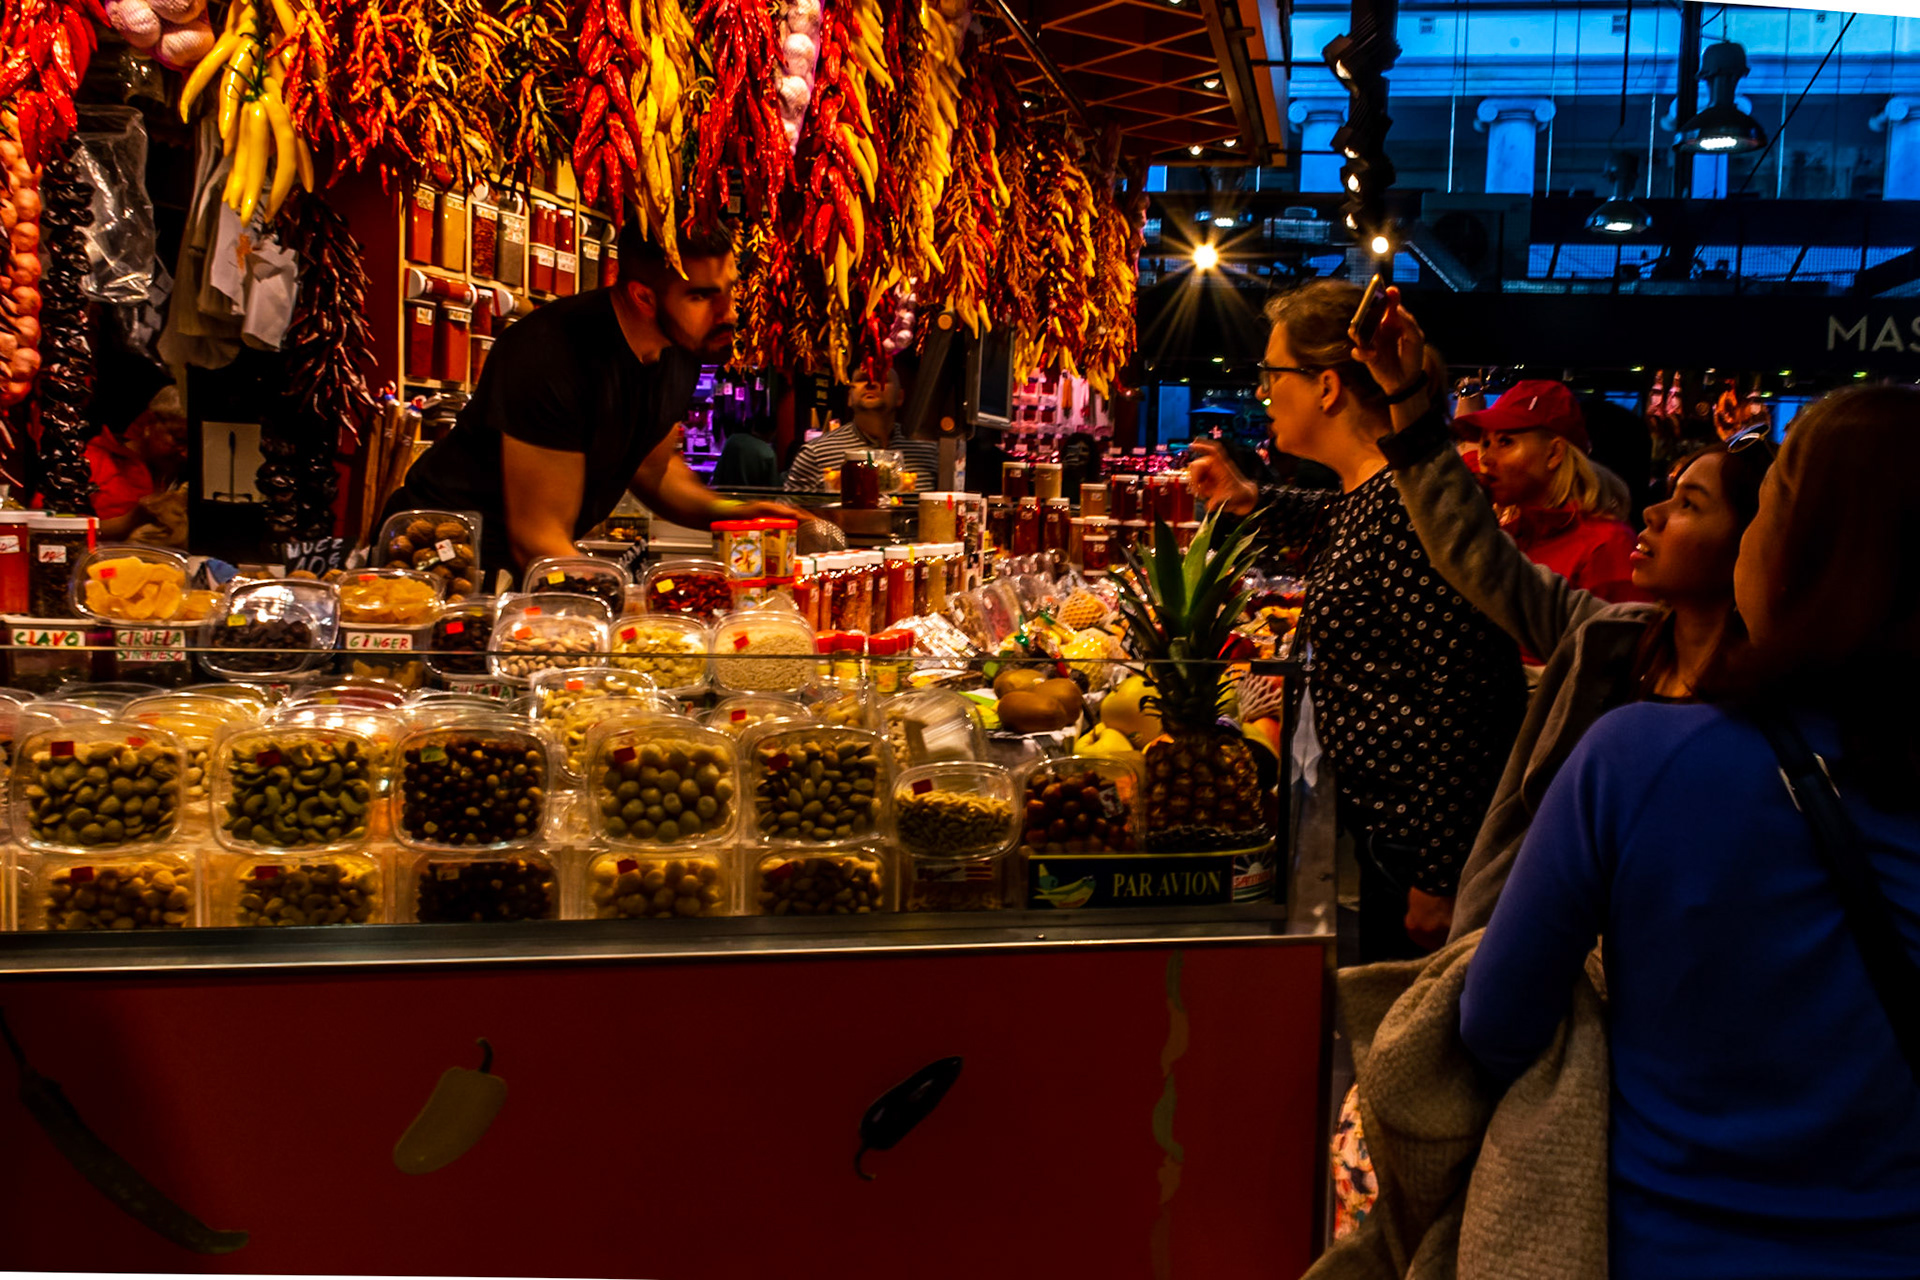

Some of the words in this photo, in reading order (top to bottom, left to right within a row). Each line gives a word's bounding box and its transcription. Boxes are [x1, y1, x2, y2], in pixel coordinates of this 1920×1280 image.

[15, 631, 80, 646] CLAVO
[117, 630, 182, 647] CIRUELA
[350, 635, 409, 648] GINGER
[1112, 872, 1152, 898] PAR
[1157, 870, 1222, 897] AVION
